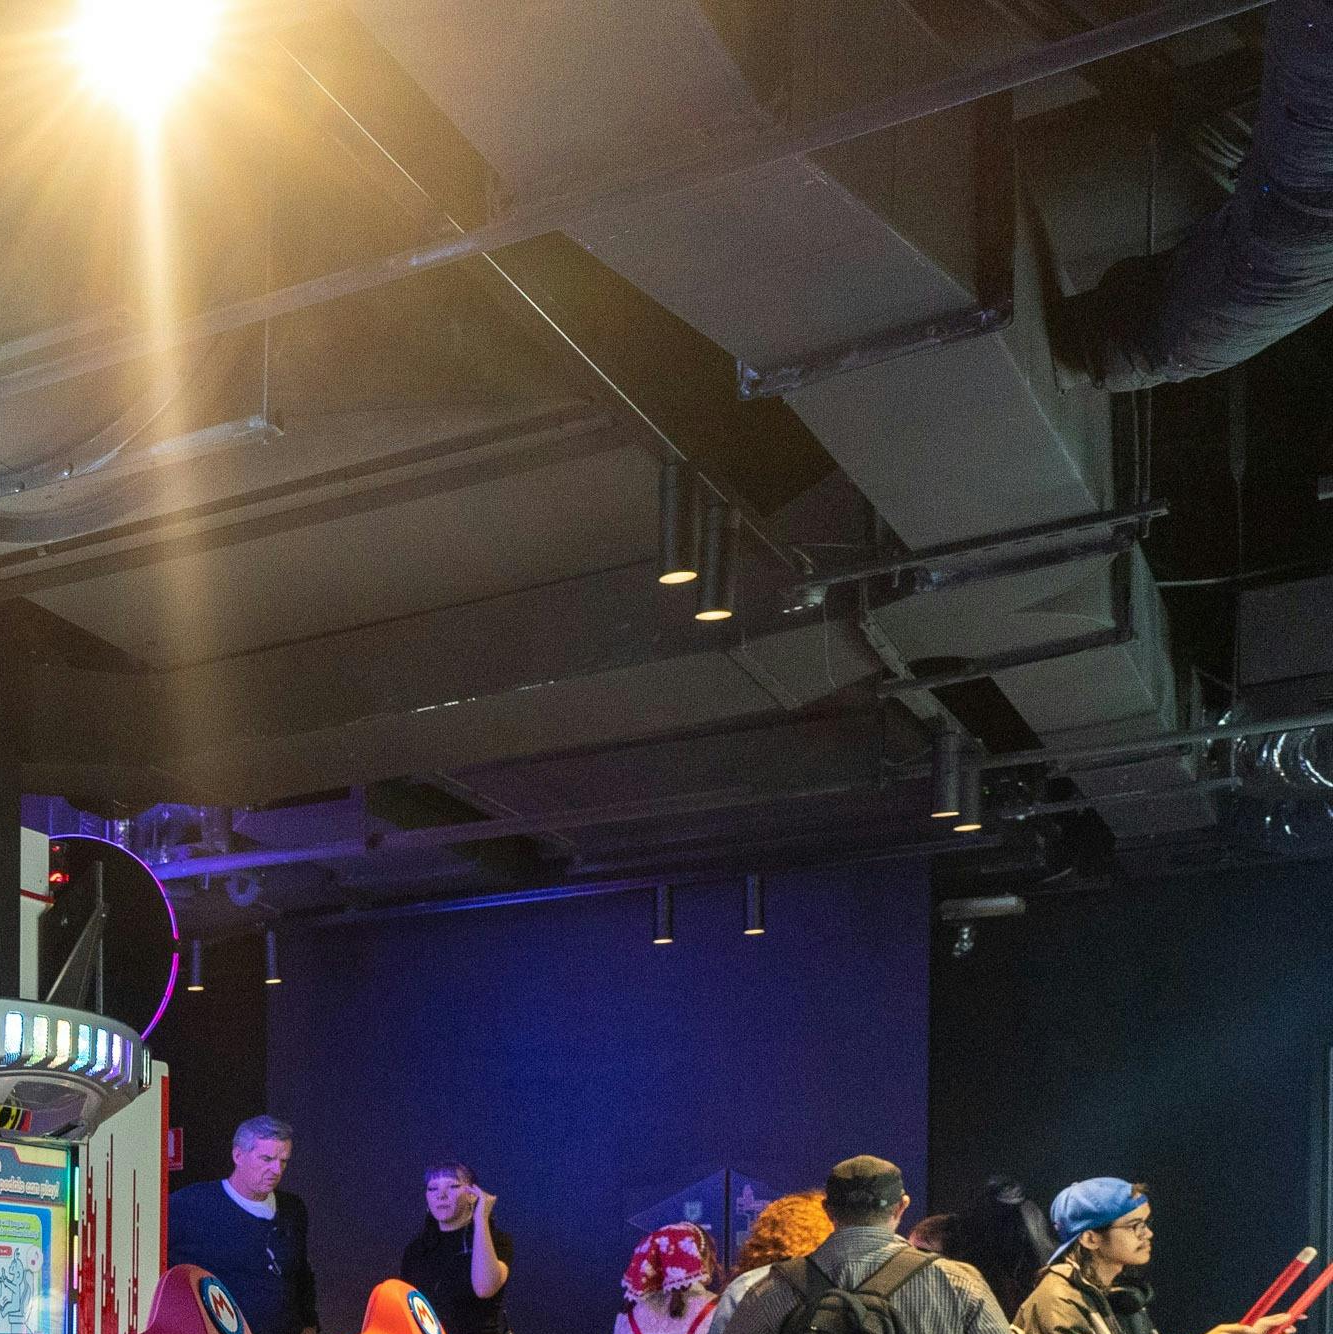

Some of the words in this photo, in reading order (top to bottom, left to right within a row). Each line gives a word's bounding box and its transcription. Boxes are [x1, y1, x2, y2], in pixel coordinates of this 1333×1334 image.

[25, 1181, 40, 1194] can
[41, 1180, 60, 1199] play!
[211, 1292, 235, 1320] M
[416, 1306, 434, 1325] M
